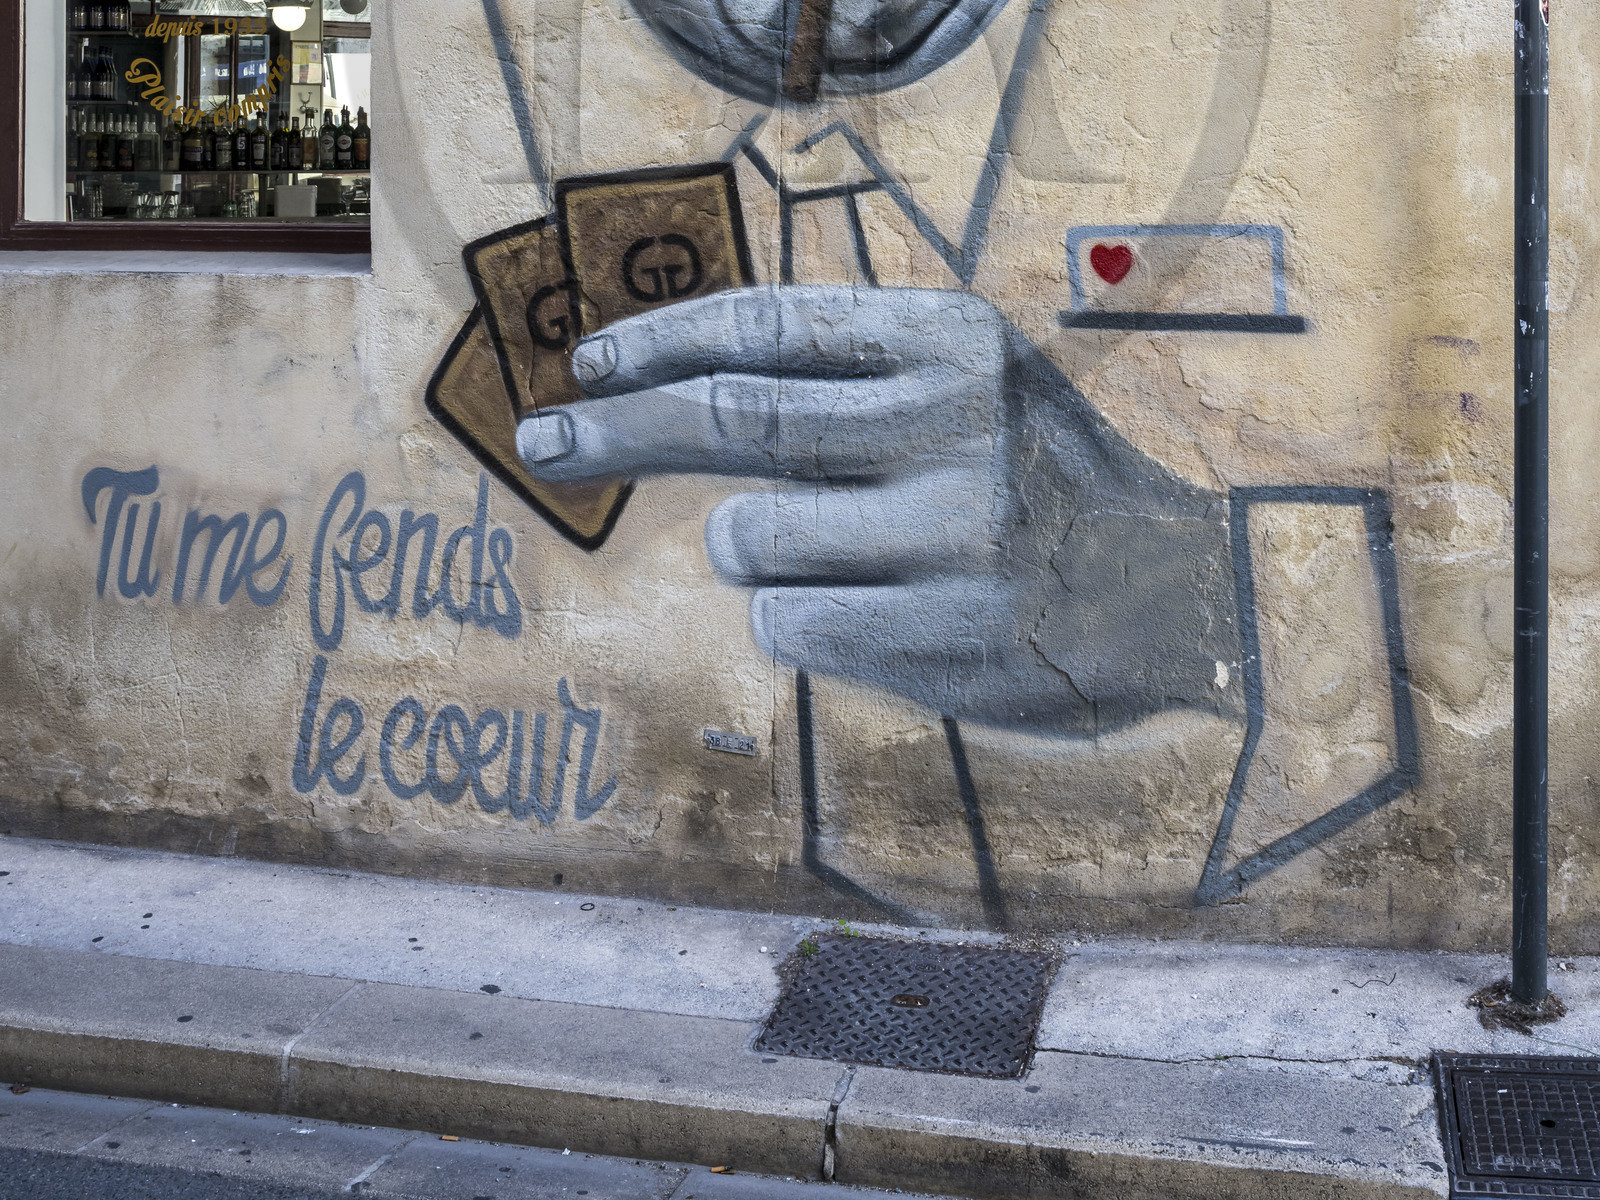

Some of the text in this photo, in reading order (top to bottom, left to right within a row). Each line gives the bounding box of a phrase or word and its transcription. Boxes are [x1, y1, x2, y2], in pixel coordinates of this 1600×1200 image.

[145, 14, 203, 43] depuis
[125, 54, 291, 126] Plaisir compris
[81, 465, 522, 652] Tu me fends
[292, 656, 366, 796] le
